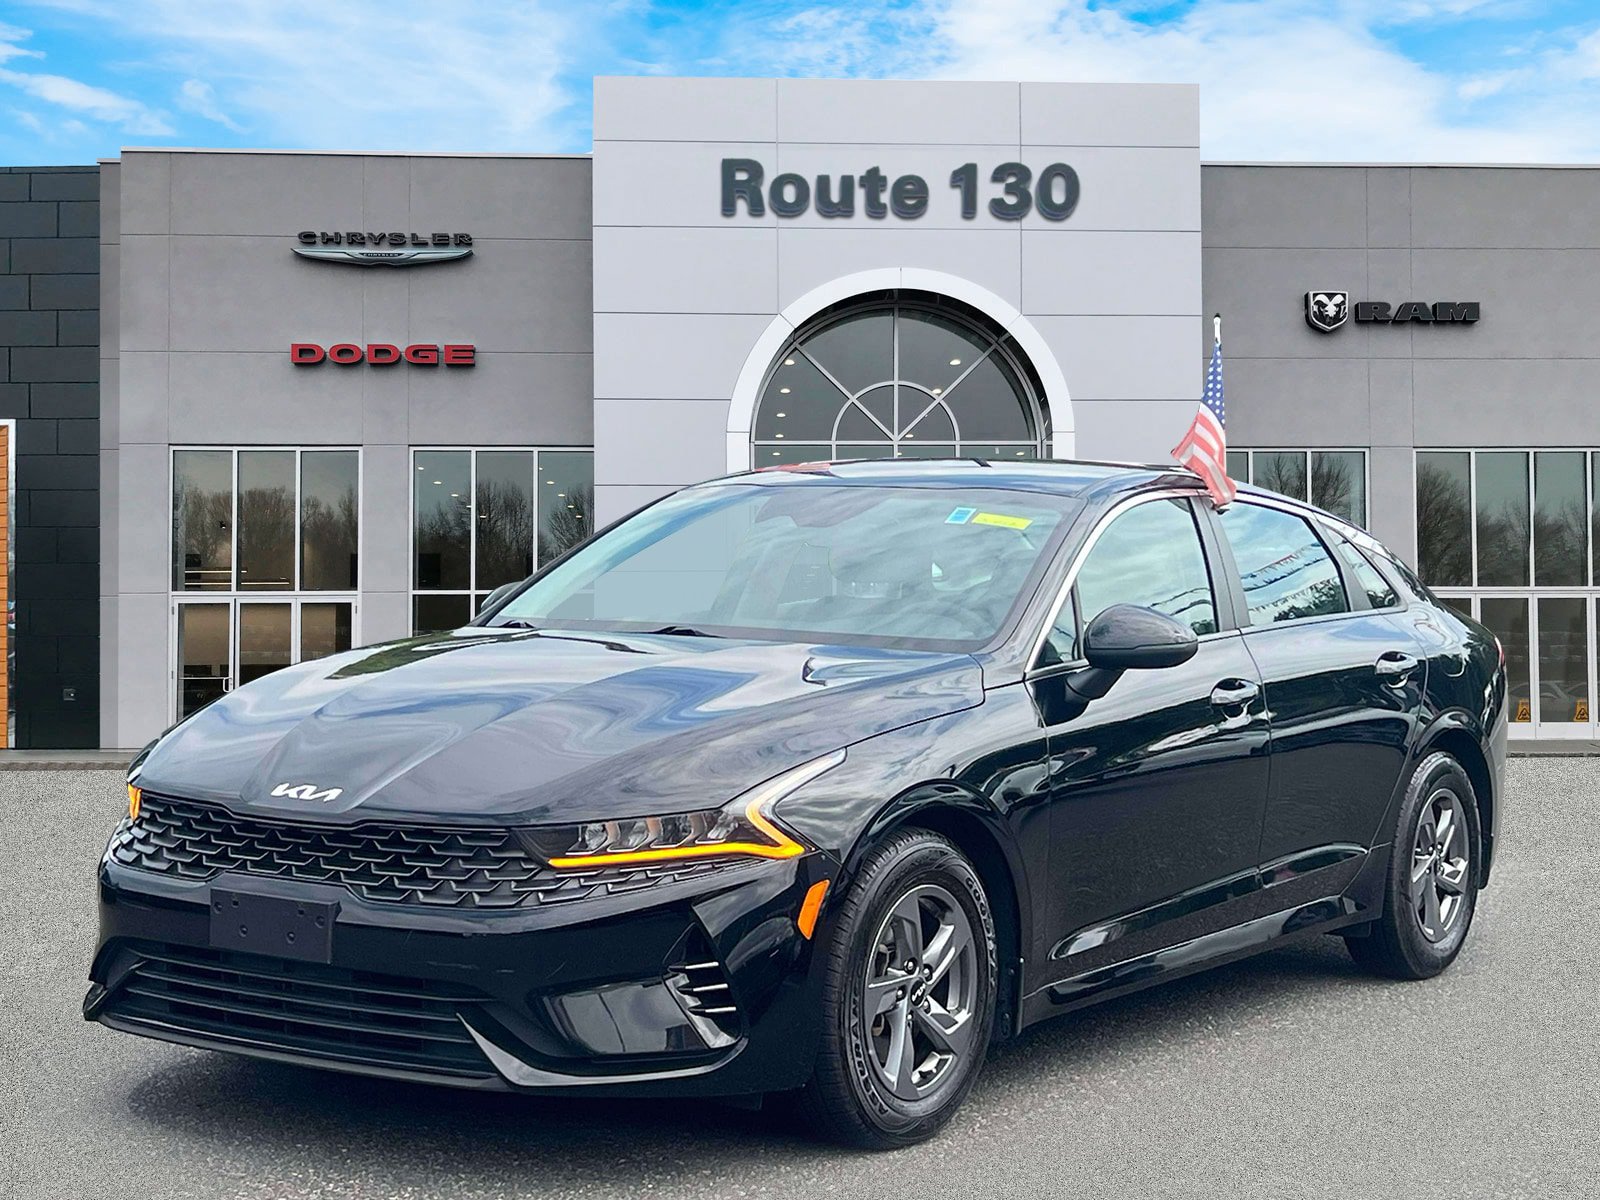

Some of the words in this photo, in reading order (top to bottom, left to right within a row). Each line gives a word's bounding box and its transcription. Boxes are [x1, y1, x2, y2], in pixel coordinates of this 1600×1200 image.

[720, 157, 930, 219] Route
[950, 161, 1081, 222] 130
[297, 231, 473, 246] CHRYSLER
[1354, 301, 1481, 324] RAM
[290, 343, 476, 366] DODGE
